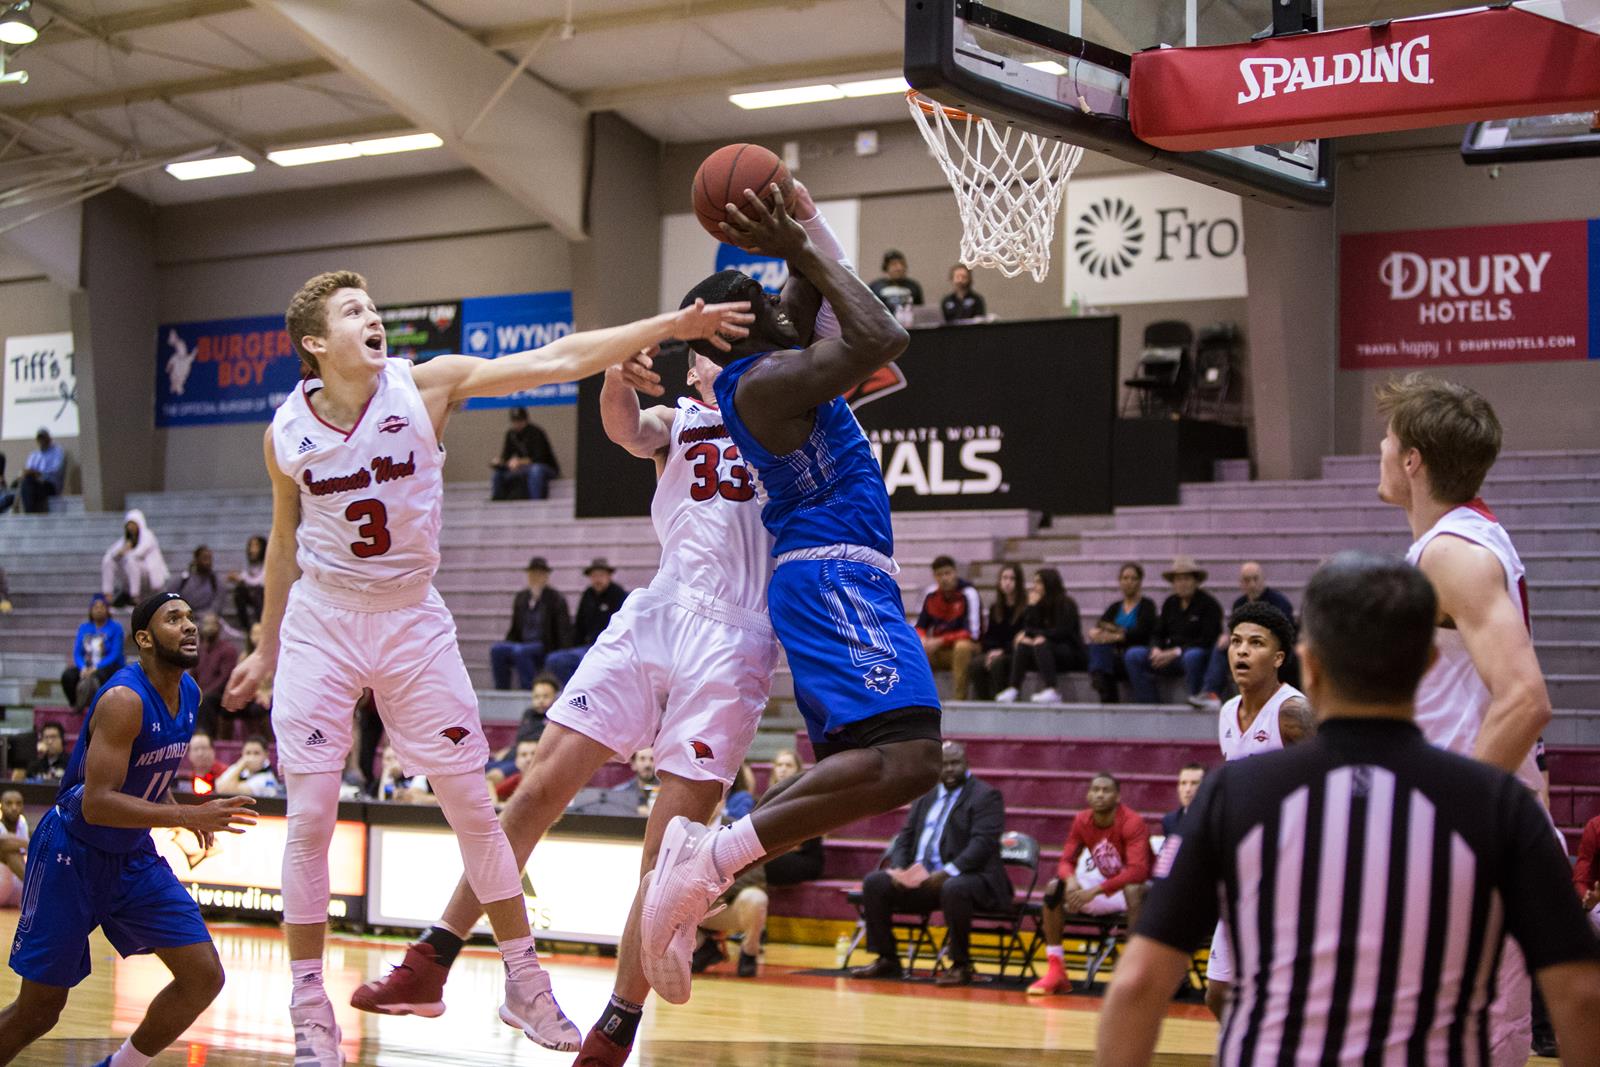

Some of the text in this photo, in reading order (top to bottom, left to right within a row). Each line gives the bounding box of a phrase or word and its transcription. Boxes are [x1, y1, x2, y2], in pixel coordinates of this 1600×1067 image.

[1238, 35, 1430, 105] SPALDING
[1155, 207, 1239, 262] Fro
[1379, 251, 1552, 300] DRURY
[1418, 300, 1513, 324] HOTELS
[195, 330, 292, 364] BURGER
[496, 321, 576, 350] WYND
[1357, 336, 1576, 358] TRAVEL happy DRURYHOTELS.COM
[10, 350, 61, 380] Tiff's
[217, 360, 268, 388] BOY
[869, 427, 939, 444] ARNATE
[684, 442, 755, 502] 33
[871, 438, 1003, 497] ALS
[345, 498, 391, 558] 3
[134, 745, 167, 768] NEW
